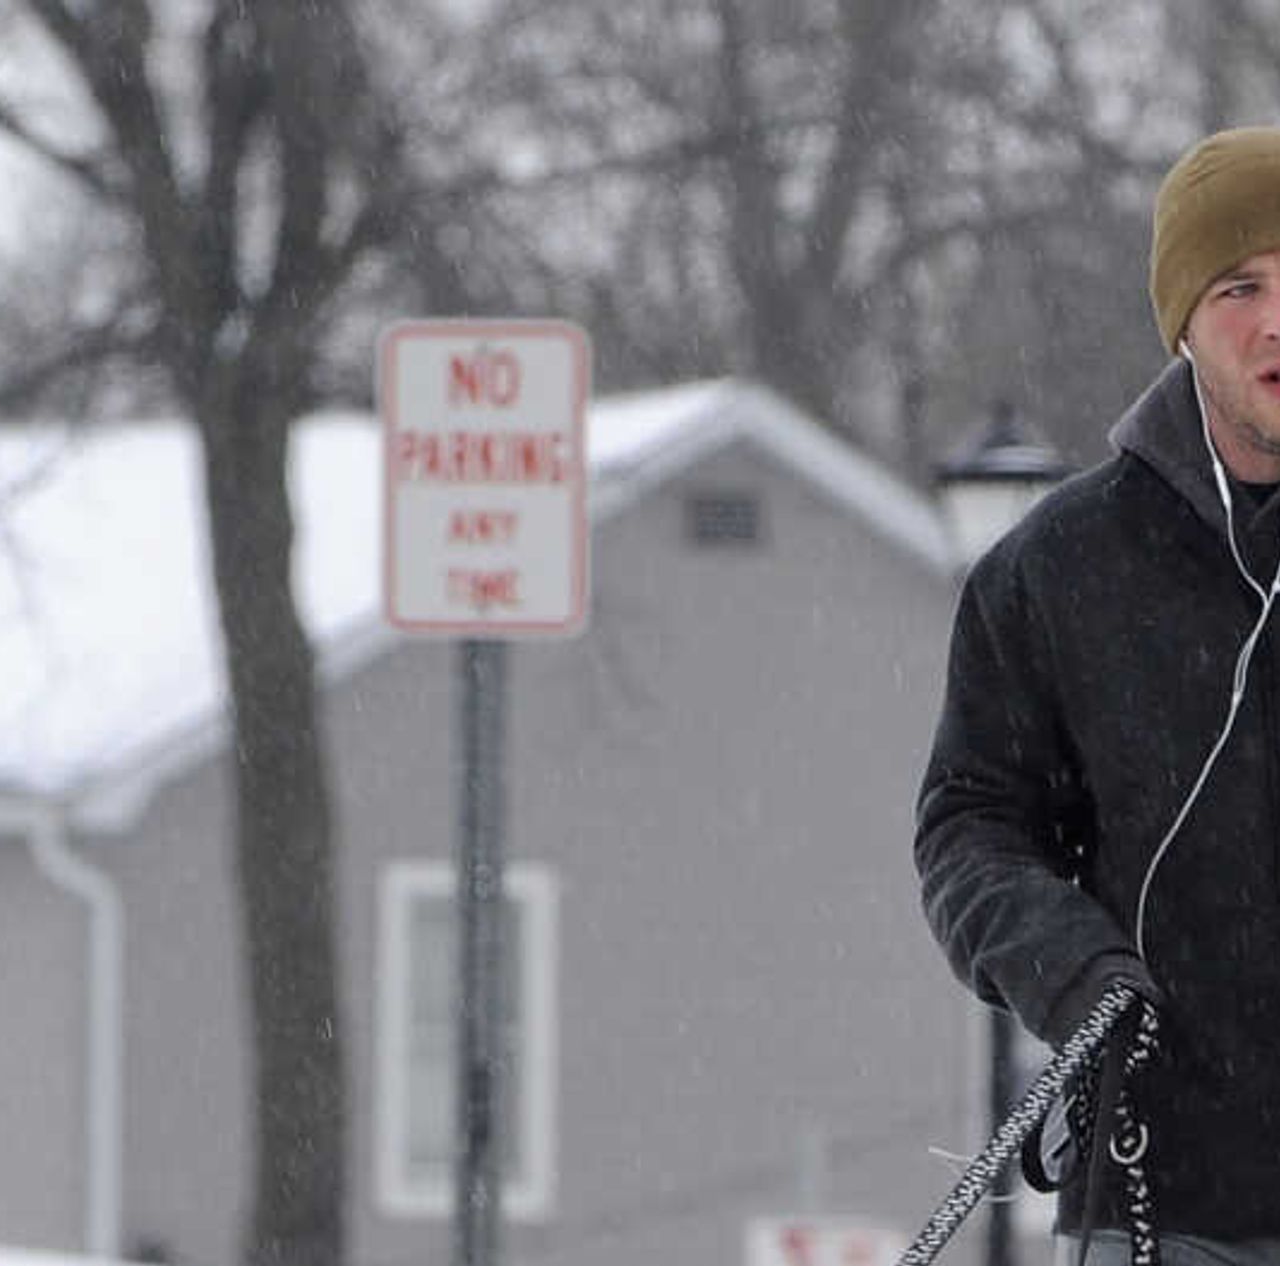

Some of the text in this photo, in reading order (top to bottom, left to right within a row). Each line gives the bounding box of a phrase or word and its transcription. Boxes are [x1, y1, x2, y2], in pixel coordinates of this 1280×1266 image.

[447, 350, 520, 405] NO
[394, 430, 569, 484] PARKING
[448, 510, 519, 545] ANY
[446, 567, 521, 606] TIME
